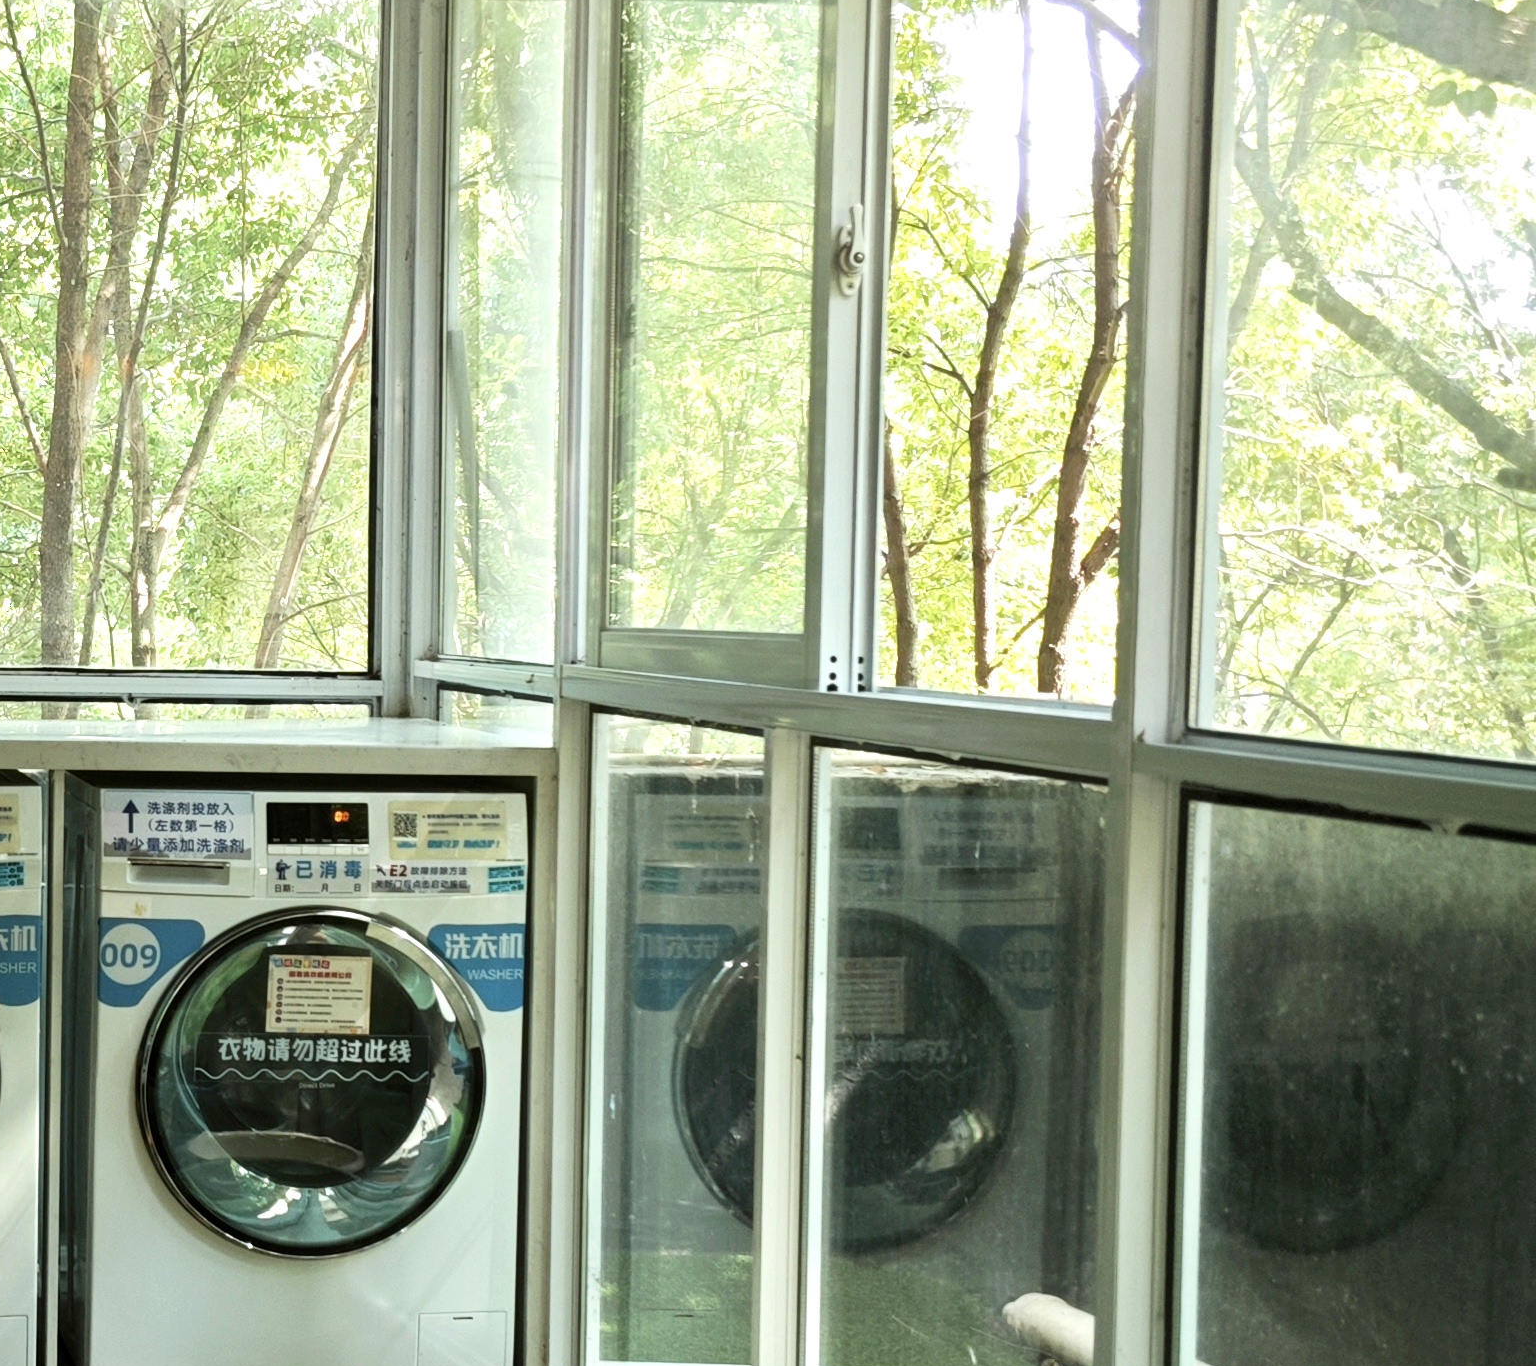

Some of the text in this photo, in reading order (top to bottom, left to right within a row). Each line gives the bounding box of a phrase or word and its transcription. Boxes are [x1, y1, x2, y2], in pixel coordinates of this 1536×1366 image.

[147, 801, 235, 816] 洗涤剂投放入
[148, 818, 234, 833] (左数第一格)
[113, 836, 245, 853] 请少量添加洗涤剂
[296, 860, 362, 879] 已消毒
[389, 864, 408, 877] E2
[444, 932, 523, 960] 洗衣机
[100, 943, 158, 968] 009
[467, 968, 523, 981] WASHER
[218, 1037, 412, 1065] 衣物请勿超过此线
